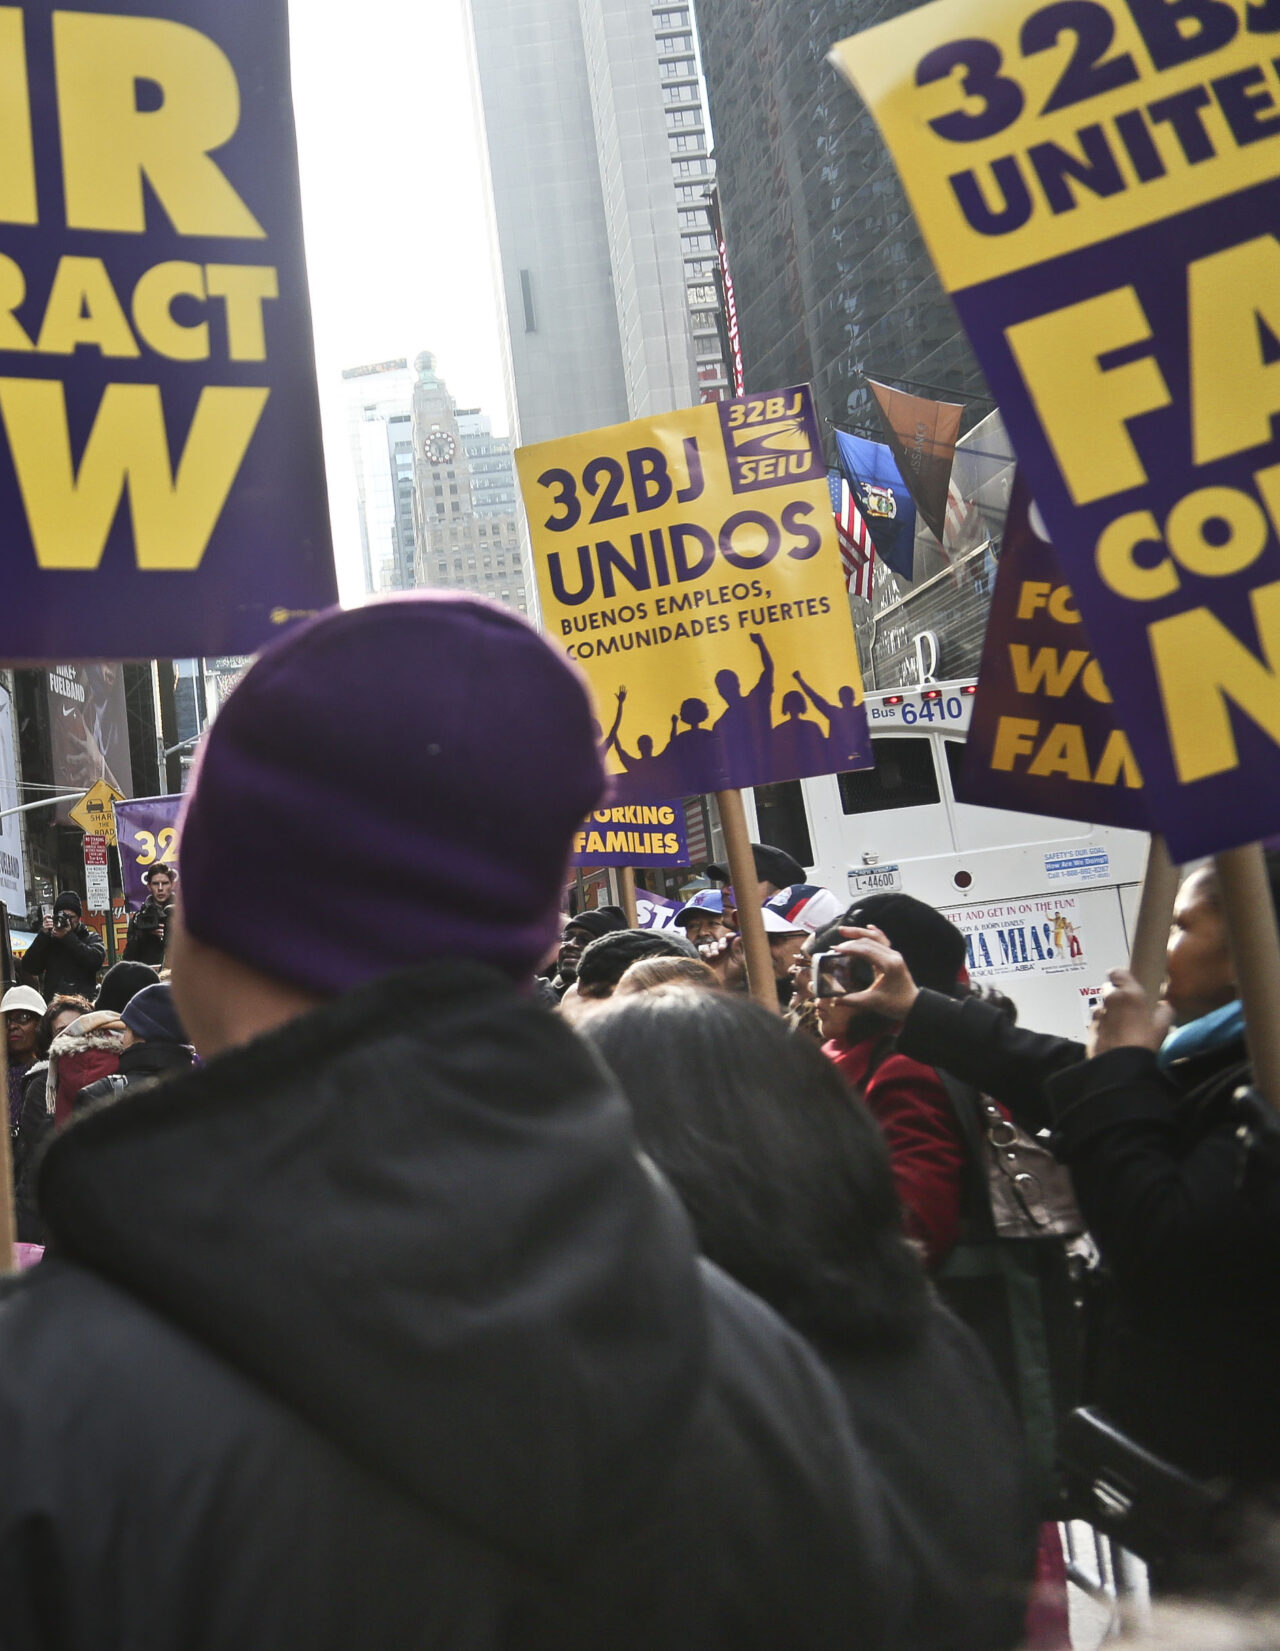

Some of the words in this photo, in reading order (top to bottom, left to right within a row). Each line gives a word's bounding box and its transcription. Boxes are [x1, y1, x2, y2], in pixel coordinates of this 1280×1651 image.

[948, 58, 1280, 237] UNITE
[728, 393, 802, 427] 32BJ
[537, 436, 705, 532] 32BJ
[740, 451, 812, 484] SEIU
[547, 501, 821, 606] UNIDOS
[561, 603, 648, 636] BUENOS
[655, 580, 772, 616] EMPLEOS,
[567, 614, 730, 662] COMUNIDADES
[738, 597, 831, 629] FUERTES
[50, 672, 85, 702] FUELBAND
[872, 707, 895, 719] Bus
[901, 697, 962, 725] 6410
[573, 831, 680, 854] FAMILIES
[966, 909, 985, 921] AND
[987, 907, 1004, 918] GET
[1006, 905, 1017, 915] IN
[1019, 903, 1033, 914] ON
[1035, 901, 1052, 912] THE
[1055, 898, 1075, 909] FUN!
[997, 922, 1055, 966] MIA!
